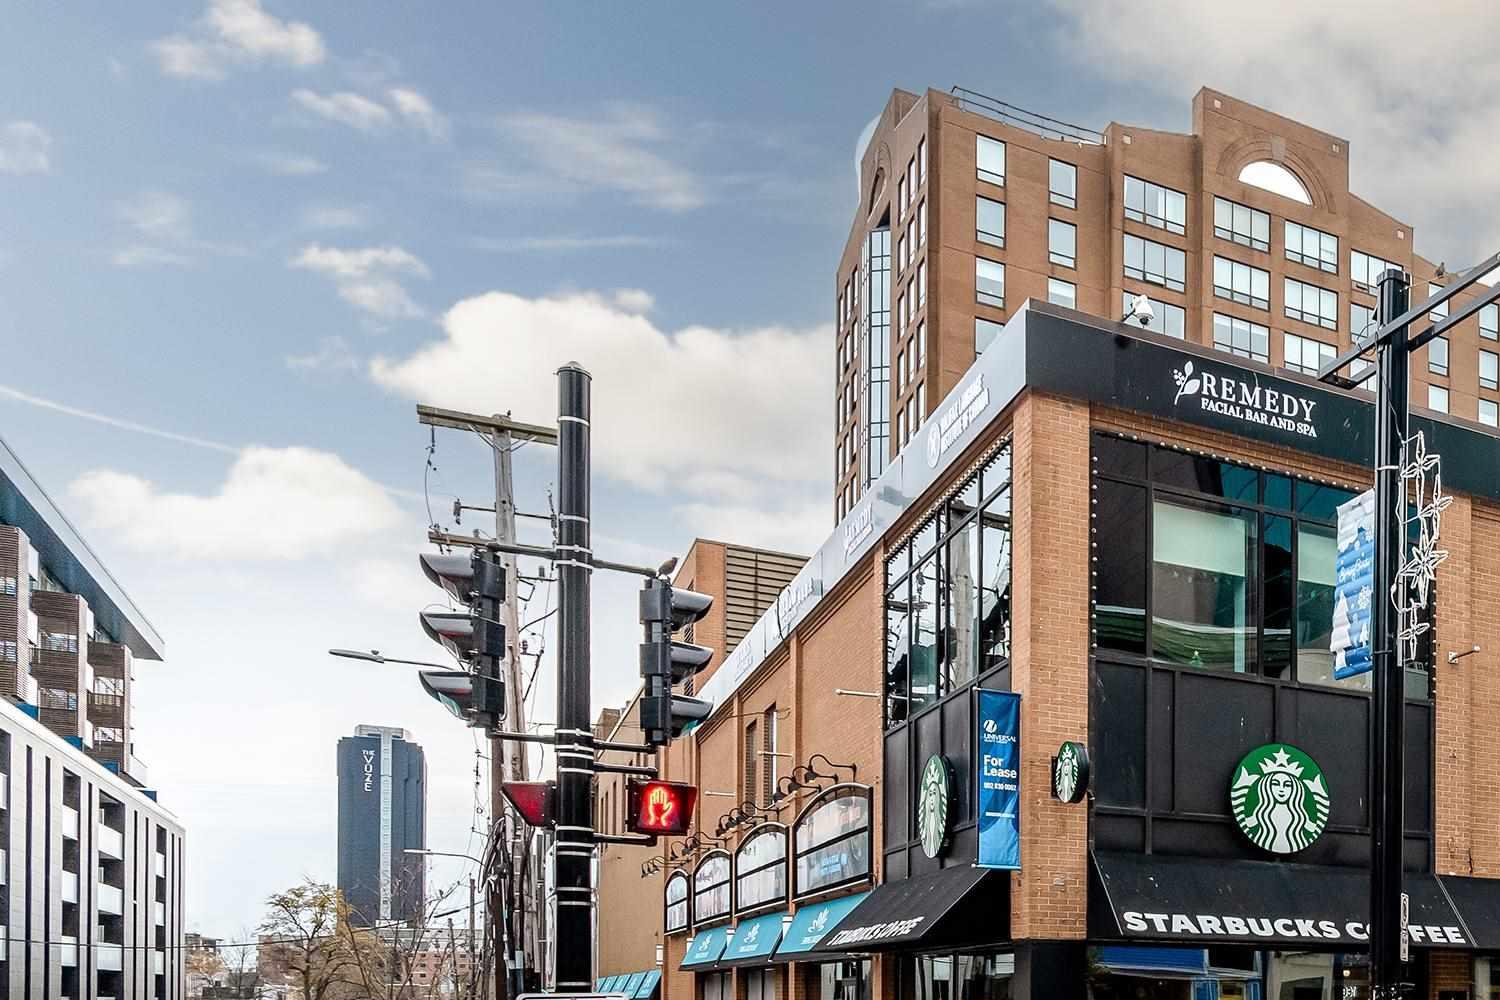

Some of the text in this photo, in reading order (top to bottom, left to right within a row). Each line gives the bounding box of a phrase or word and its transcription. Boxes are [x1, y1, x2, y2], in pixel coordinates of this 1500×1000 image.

[1201, 372, 1317, 422] REMEDY
[1201, 397, 1318, 438] FACIAL BAR AND SPA
[984, 754, 1004, 767] For
[984, 765, 1017, 779] Lease
[1122, 911, 1341, 939] STARBUCKS
[1345, 922, 1467, 944] CFEE
